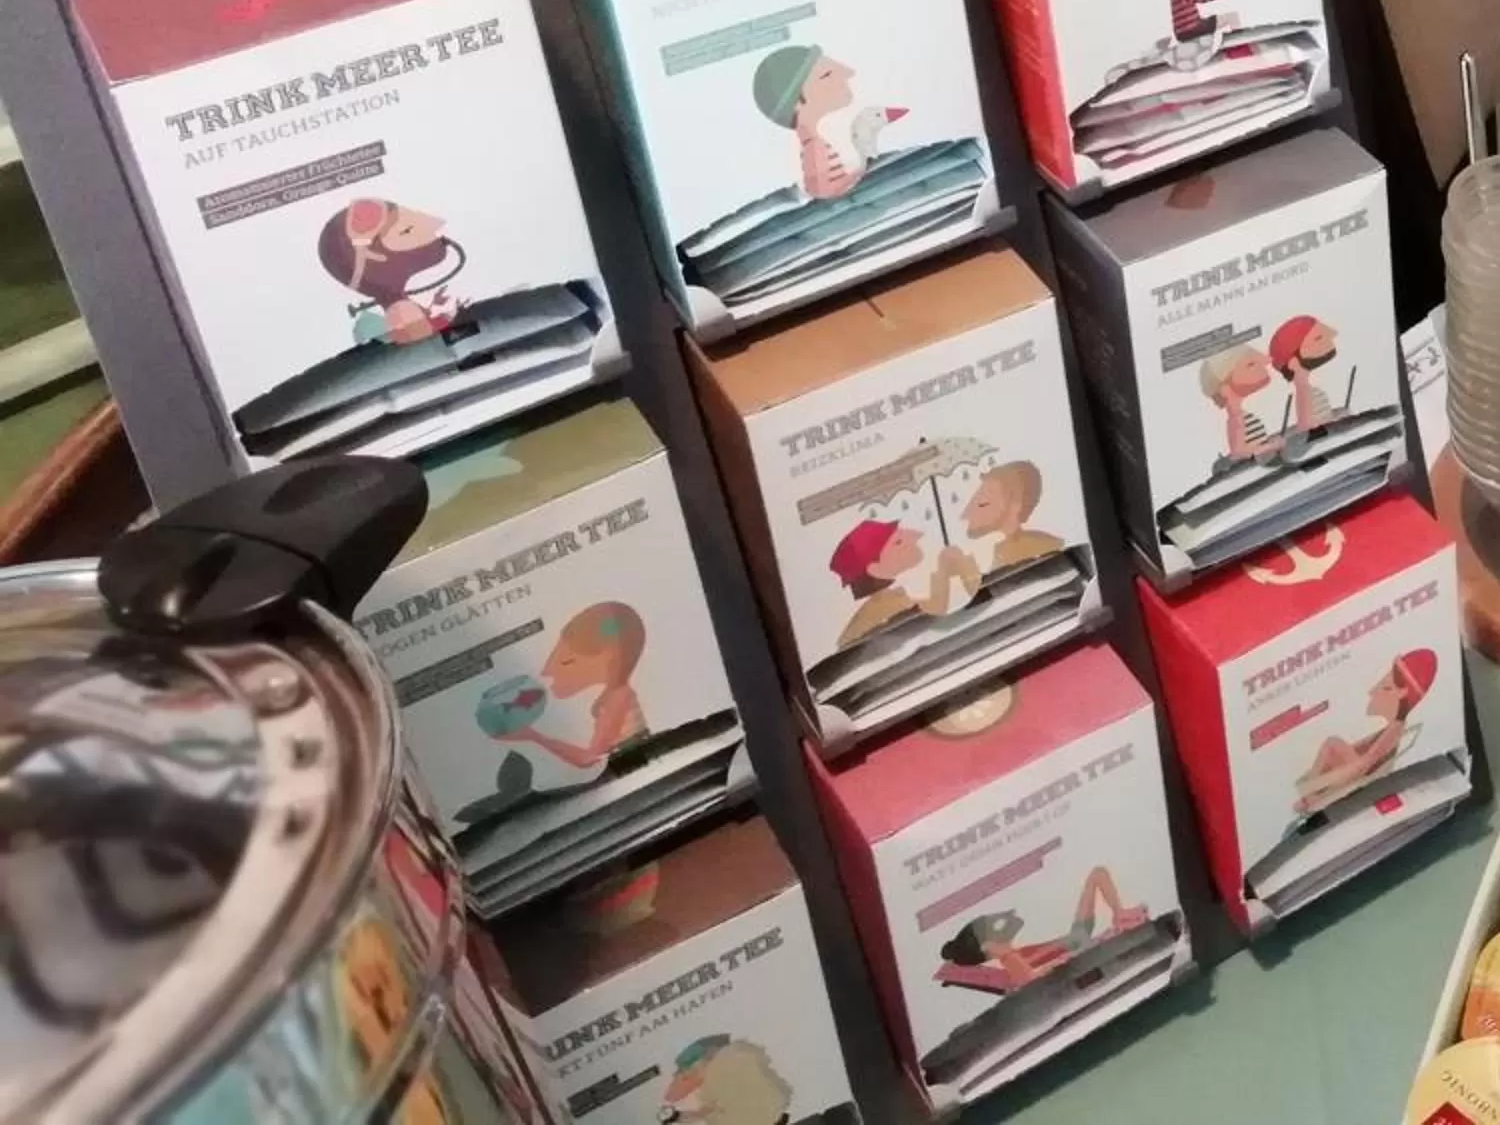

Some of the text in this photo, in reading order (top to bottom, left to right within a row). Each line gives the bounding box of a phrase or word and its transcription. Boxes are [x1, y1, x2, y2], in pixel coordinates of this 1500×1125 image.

[165, 18, 503, 142] TRINK MEER TEE
[184, 88, 400, 169] AUF TAUCHSTATION
[1151, 208, 1369, 307] TRINK MEER TEE
[1197, 283, 1245, 313] MANN
[779, 339, 1037, 458] TRINK MEER TEE
[475, 530, 583, 593] MEER
[578, 497, 650, 545] TEE
[374, 623, 437, 658] OGEN
[1243, 580, 1439, 695] TRINK MEER TEE
[904, 812, 1001, 876] TRINK
[1002, 771, 1082, 824] MEER
[1081, 743, 1135, 780] TEE
[624, 962, 722, 1022] MEER
[720, 927, 784, 971] TEE
[673, 979, 733, 1020] HAFEN
